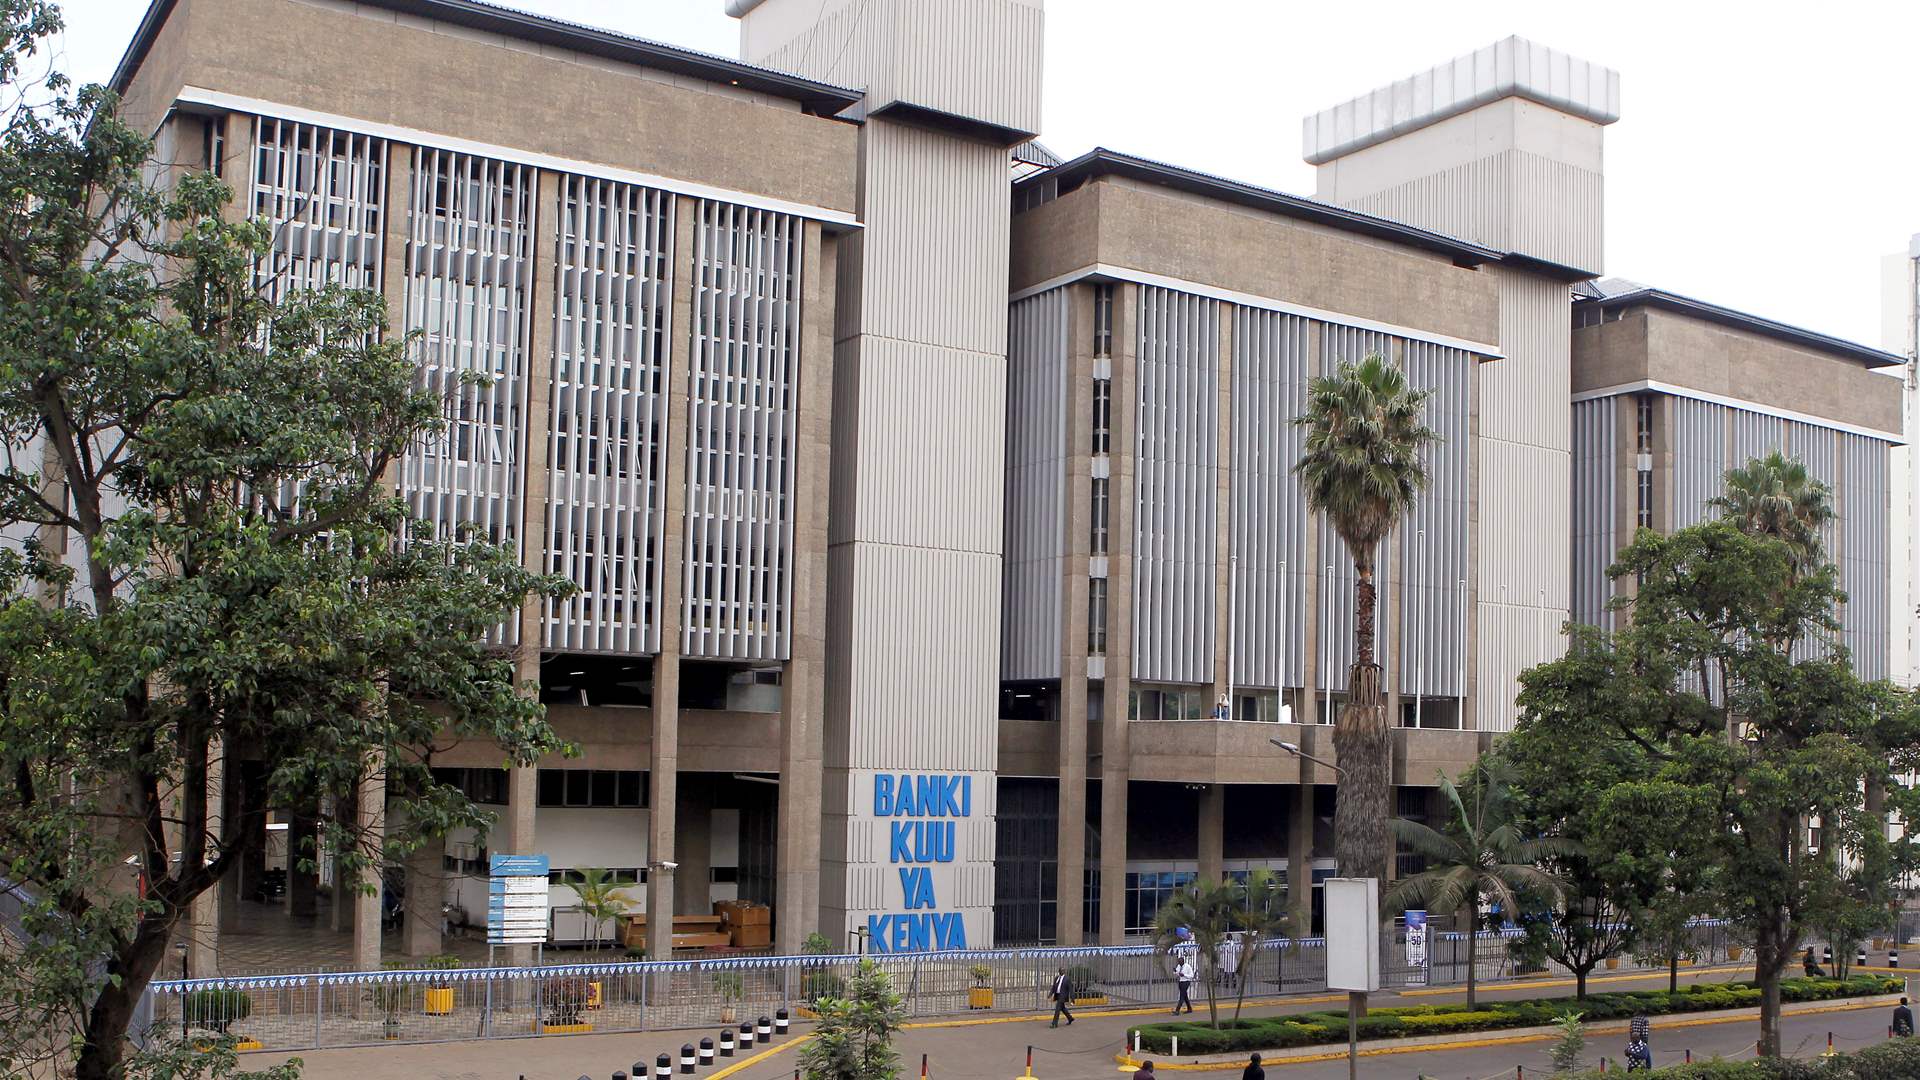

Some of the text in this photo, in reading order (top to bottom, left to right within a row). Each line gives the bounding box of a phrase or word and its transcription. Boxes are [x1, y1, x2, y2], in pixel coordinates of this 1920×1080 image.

[874, 774, 972, 817] BANKI
[891, 821, 956, 863] KUU
[899, 867, 936, 909] YA
[868, 912, 967, 953] KENYA
